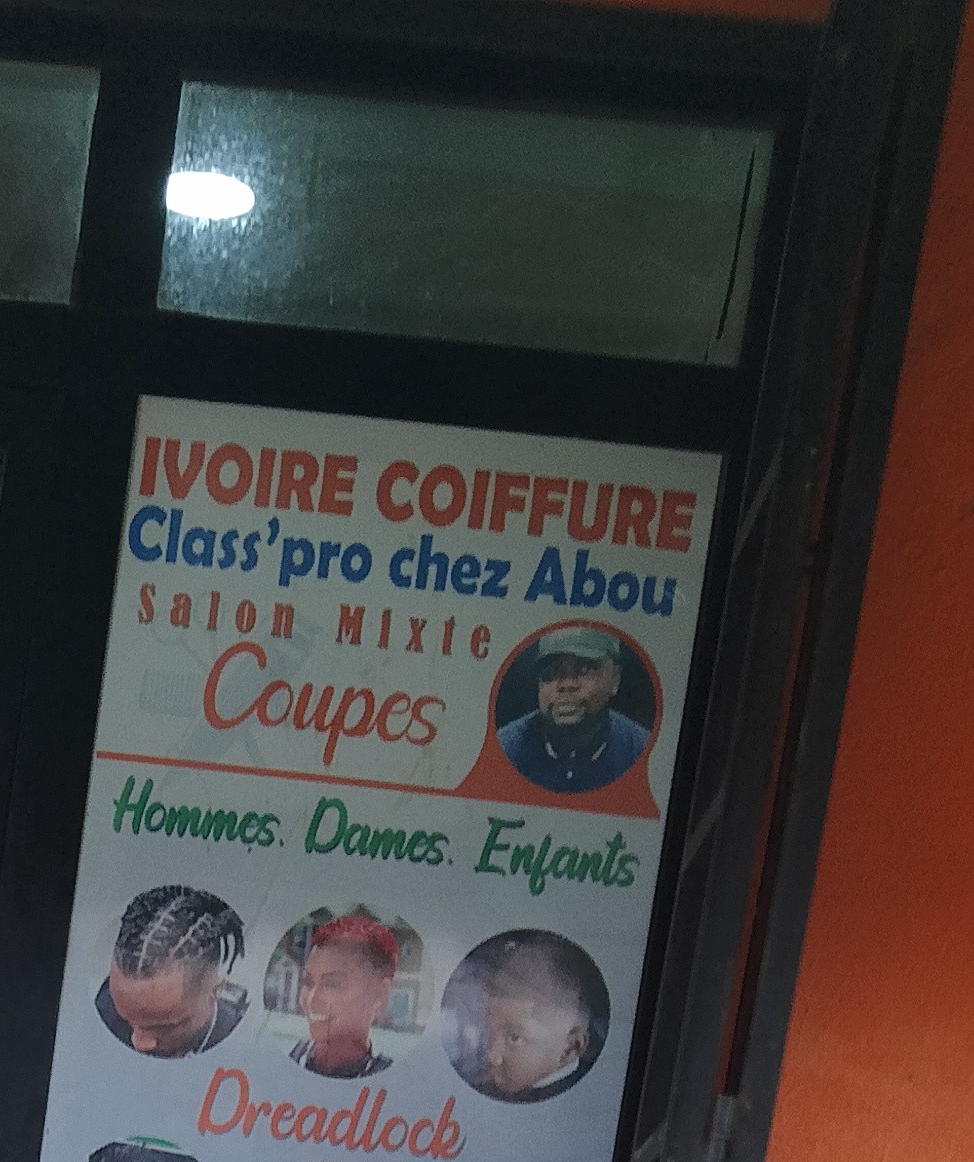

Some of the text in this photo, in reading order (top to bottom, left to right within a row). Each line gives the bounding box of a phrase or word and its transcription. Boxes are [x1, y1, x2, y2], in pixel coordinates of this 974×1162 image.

[138, 436, 698, 552] IVOIRE COIFFURE
[128, 505, 677, 617] Class'pro chez Abou
[138, 582, 296, 639] Salon
[203, 641, 446, 766] Coupes
[474, 816, 641, 897] Enfants
[197, 1066, 467, 1160] Dreadlock
